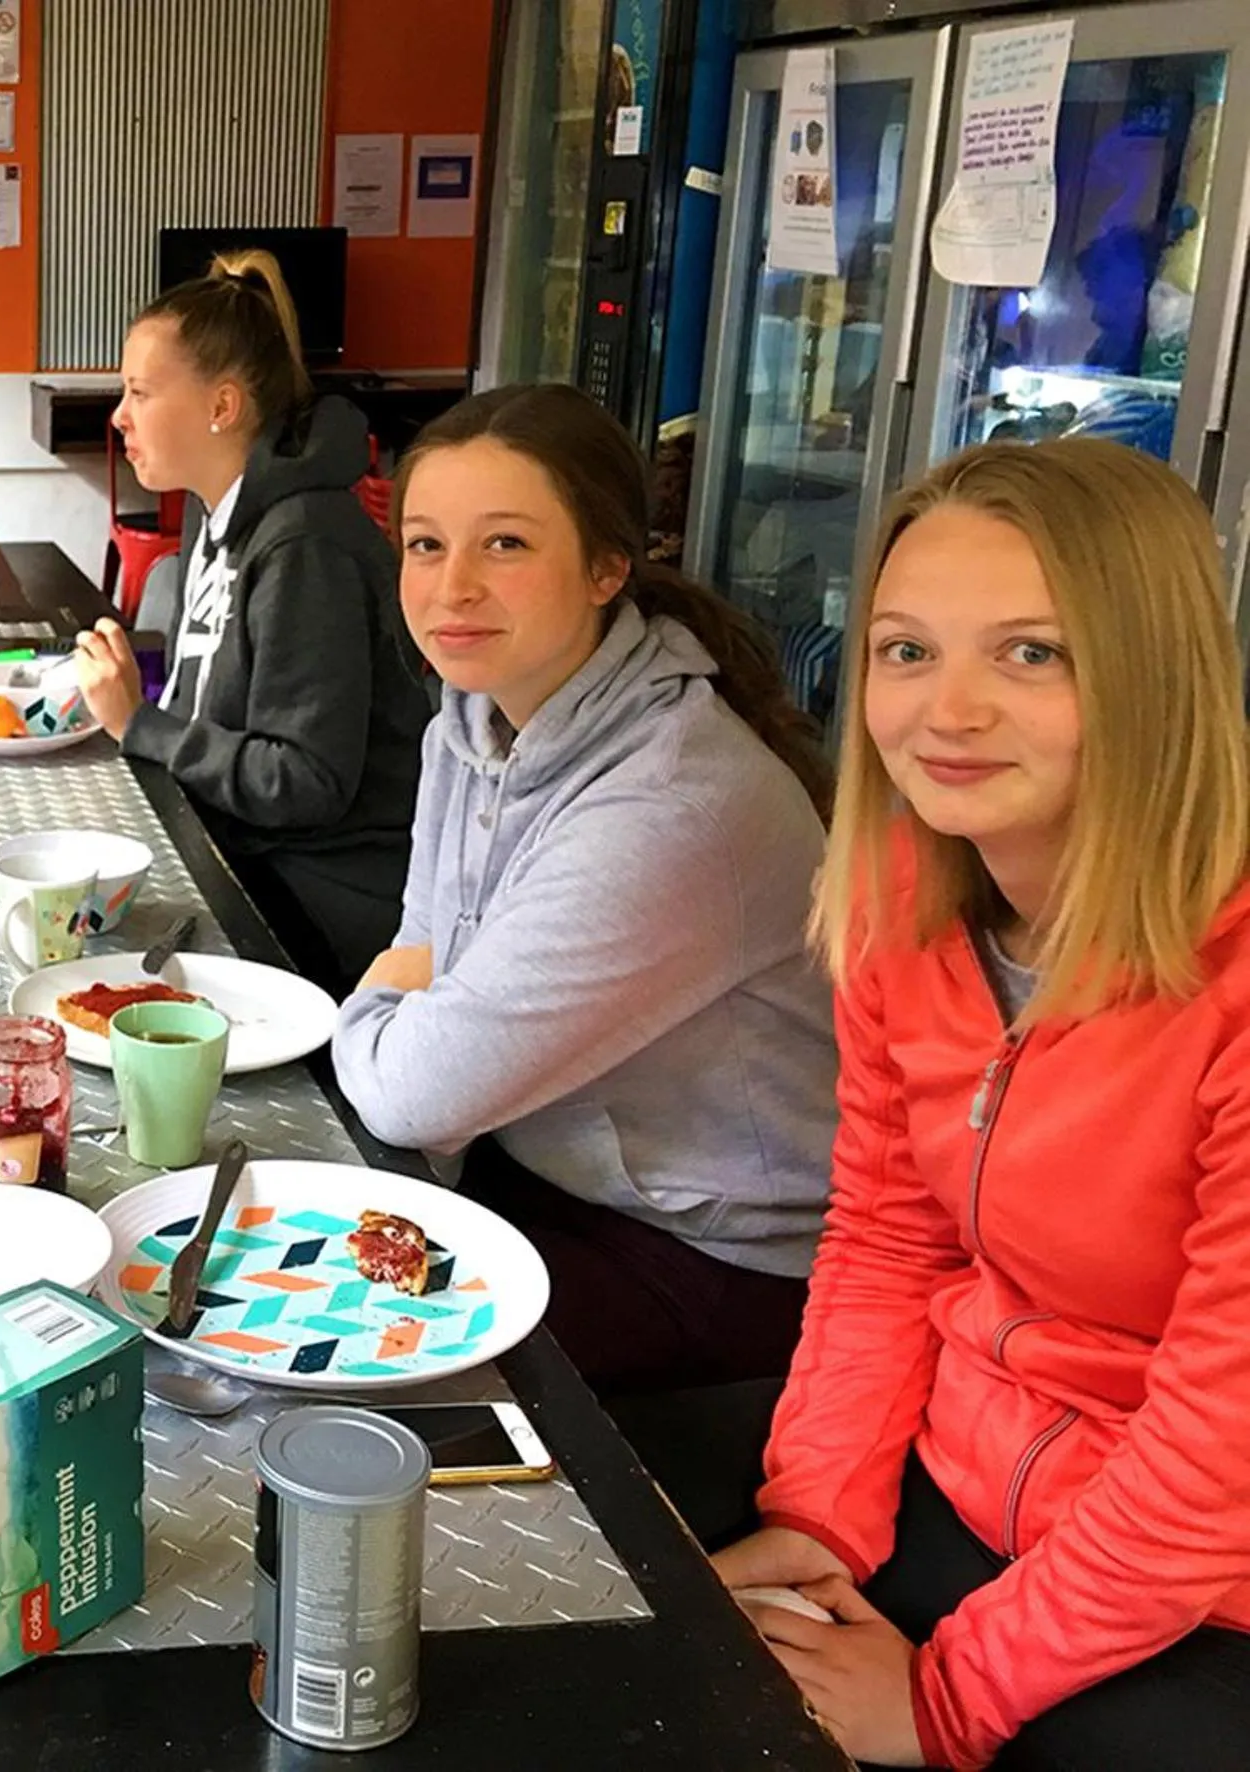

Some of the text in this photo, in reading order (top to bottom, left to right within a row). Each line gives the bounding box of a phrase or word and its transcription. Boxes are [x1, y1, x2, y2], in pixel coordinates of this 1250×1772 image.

[55, 1462, 81, 1616] peppermint
[78, 1502, 97, 1605] infusion
[30, 1595, 43, 1641] coles
